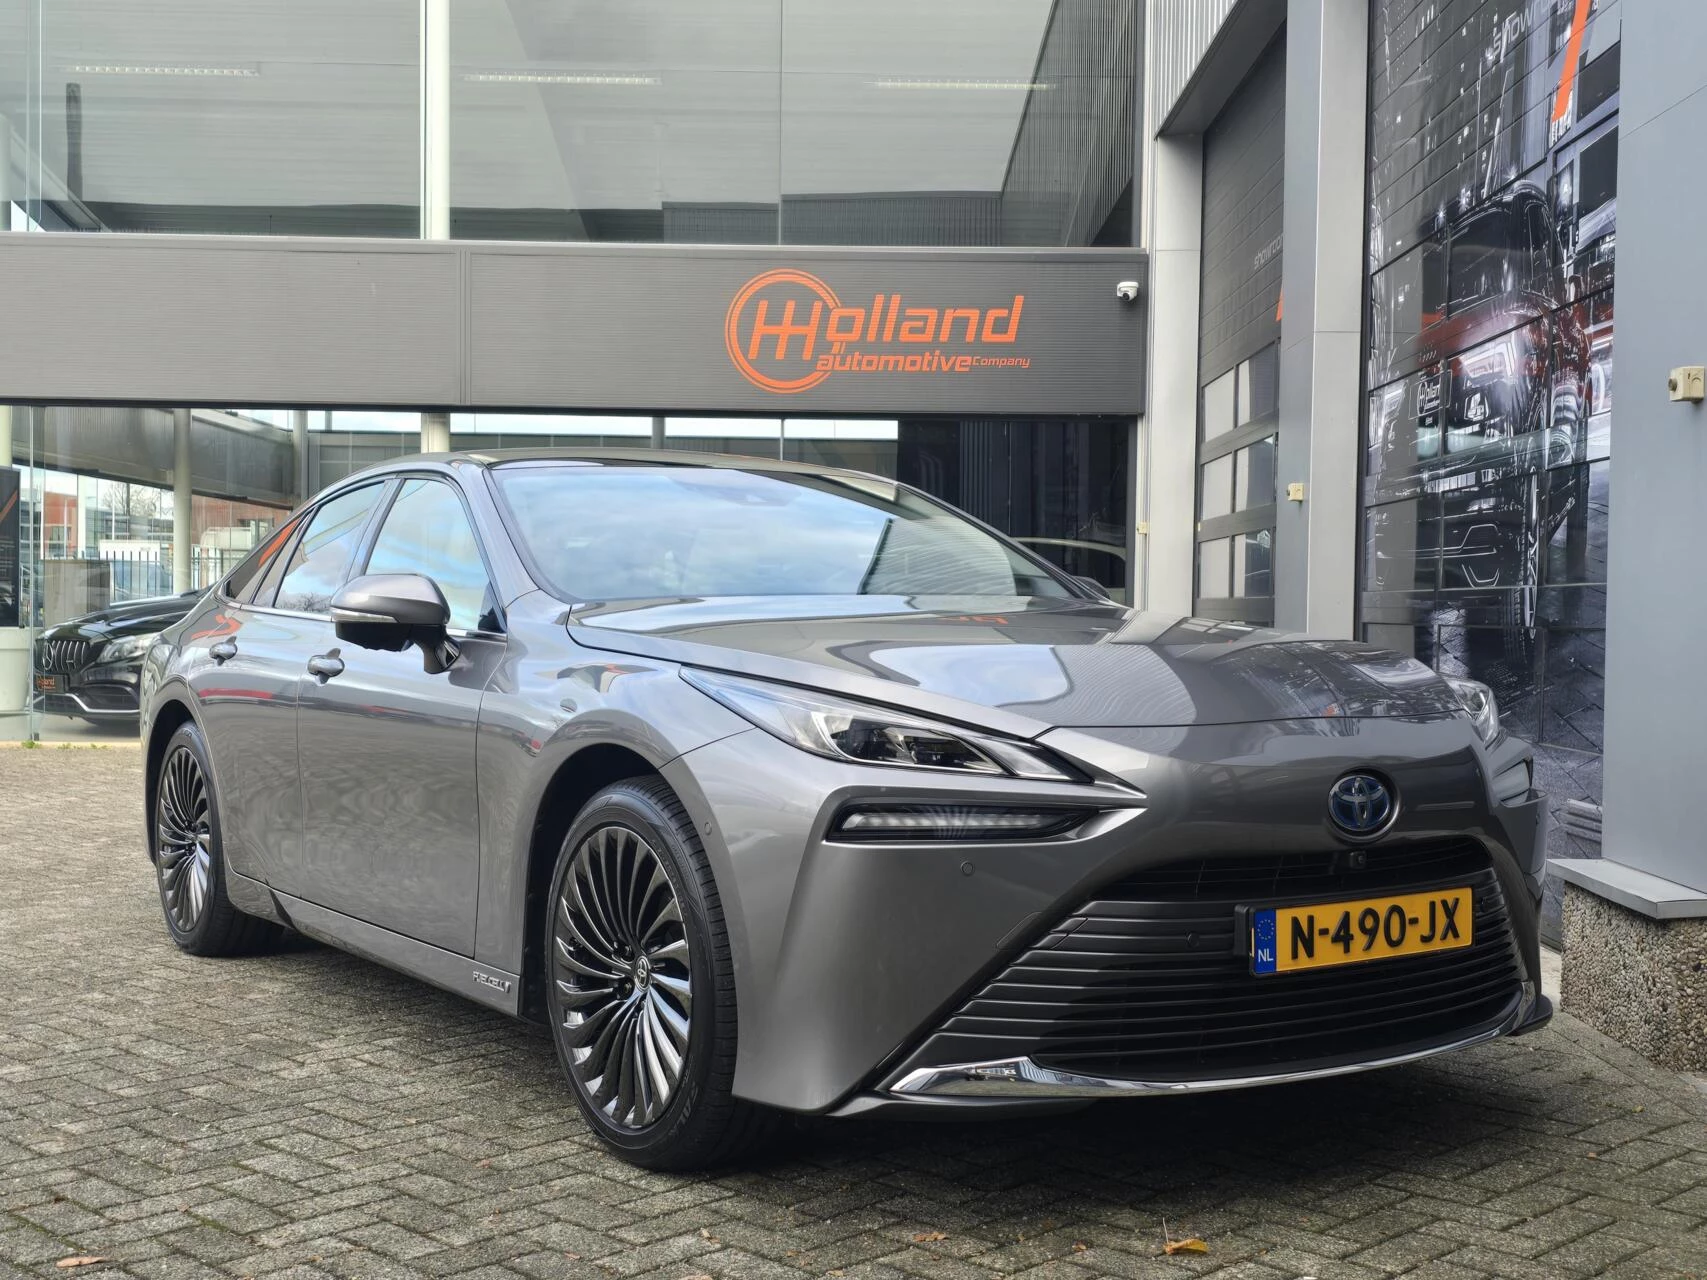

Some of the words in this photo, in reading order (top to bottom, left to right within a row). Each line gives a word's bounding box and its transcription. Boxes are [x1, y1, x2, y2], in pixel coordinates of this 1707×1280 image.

[816, 350, 973, 372] automotive
[972, 355, 1031, 369] Company
[1291, 897, 1460, 960] N-490-JX
[1257, 948, 1274, 963] NL
